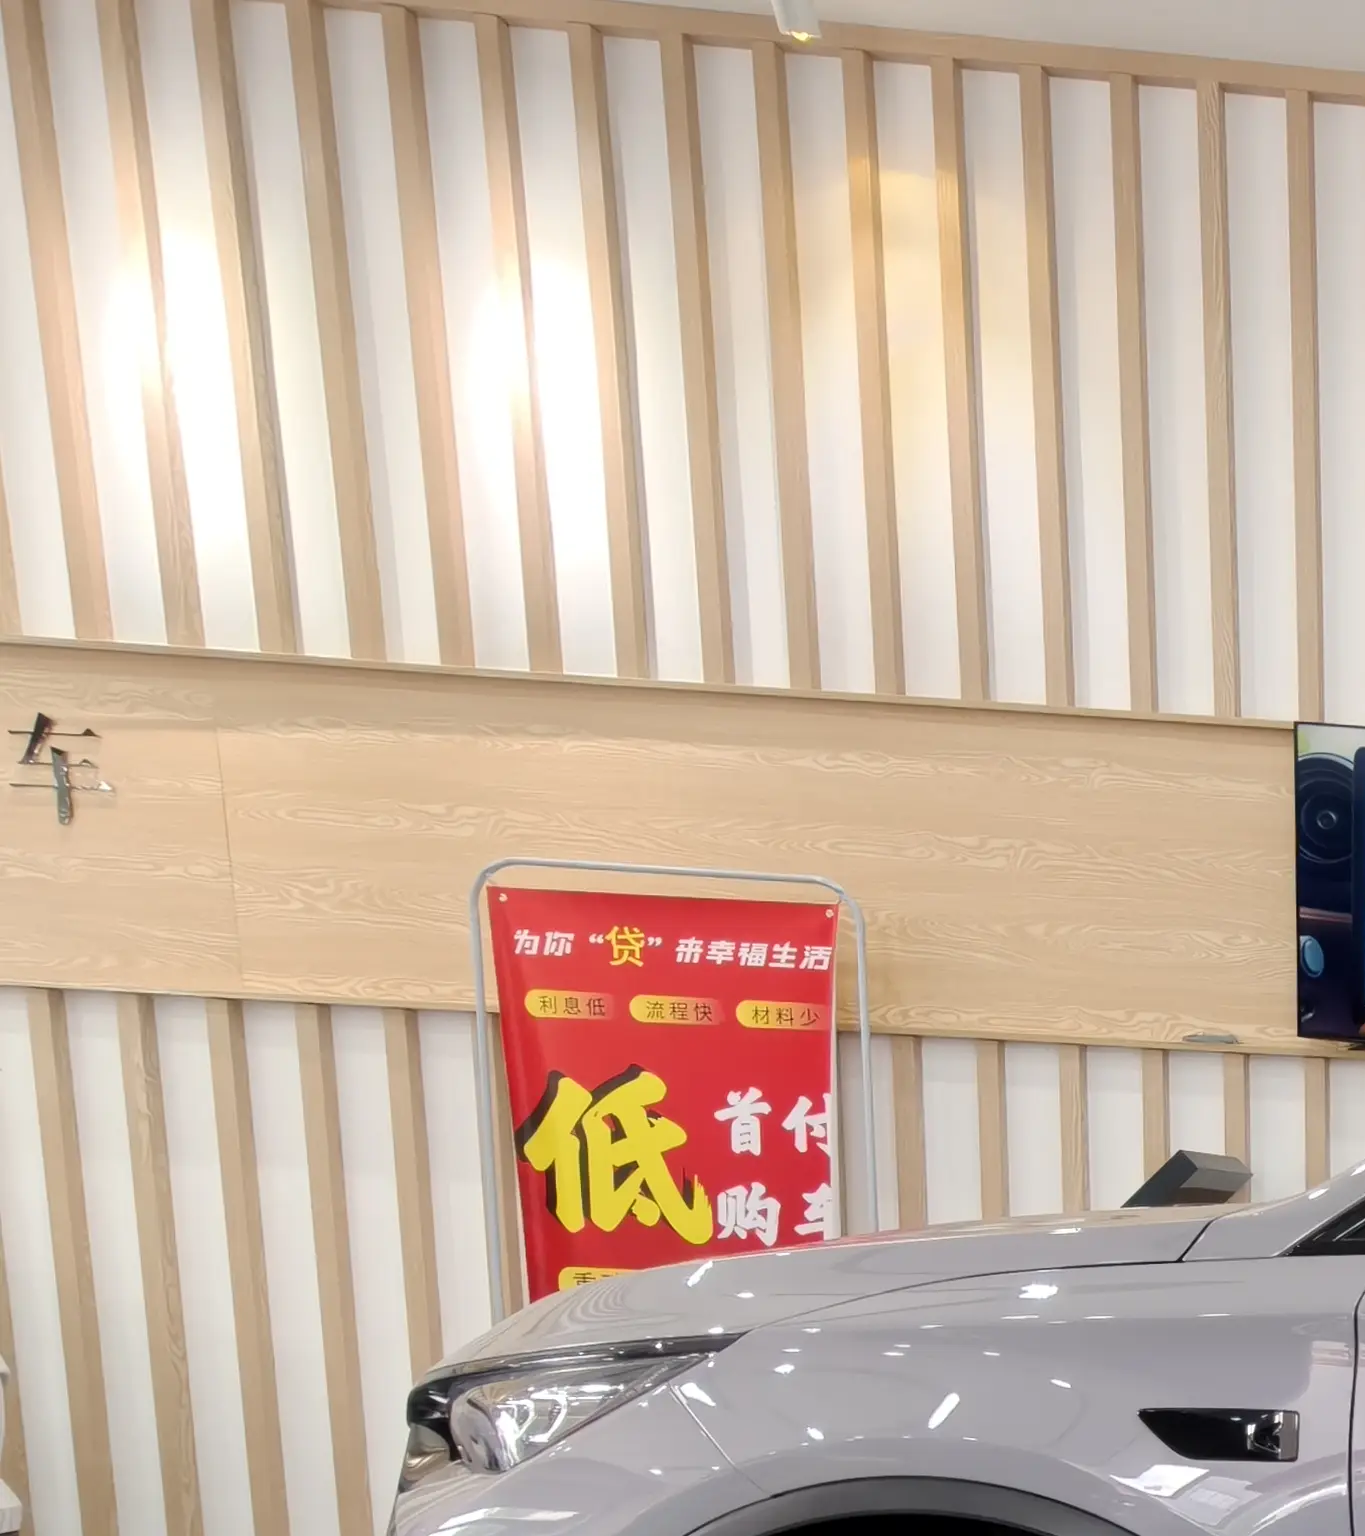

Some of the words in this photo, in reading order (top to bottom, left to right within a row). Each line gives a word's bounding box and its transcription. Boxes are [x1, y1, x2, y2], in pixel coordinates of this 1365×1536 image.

[538, 994, 606, 1018] 利息低
[645, 1000, 713, 1023] 流程快
[751, 1006, 821, 1027] 材料少
[515, 1063, 714, 1245] 低
